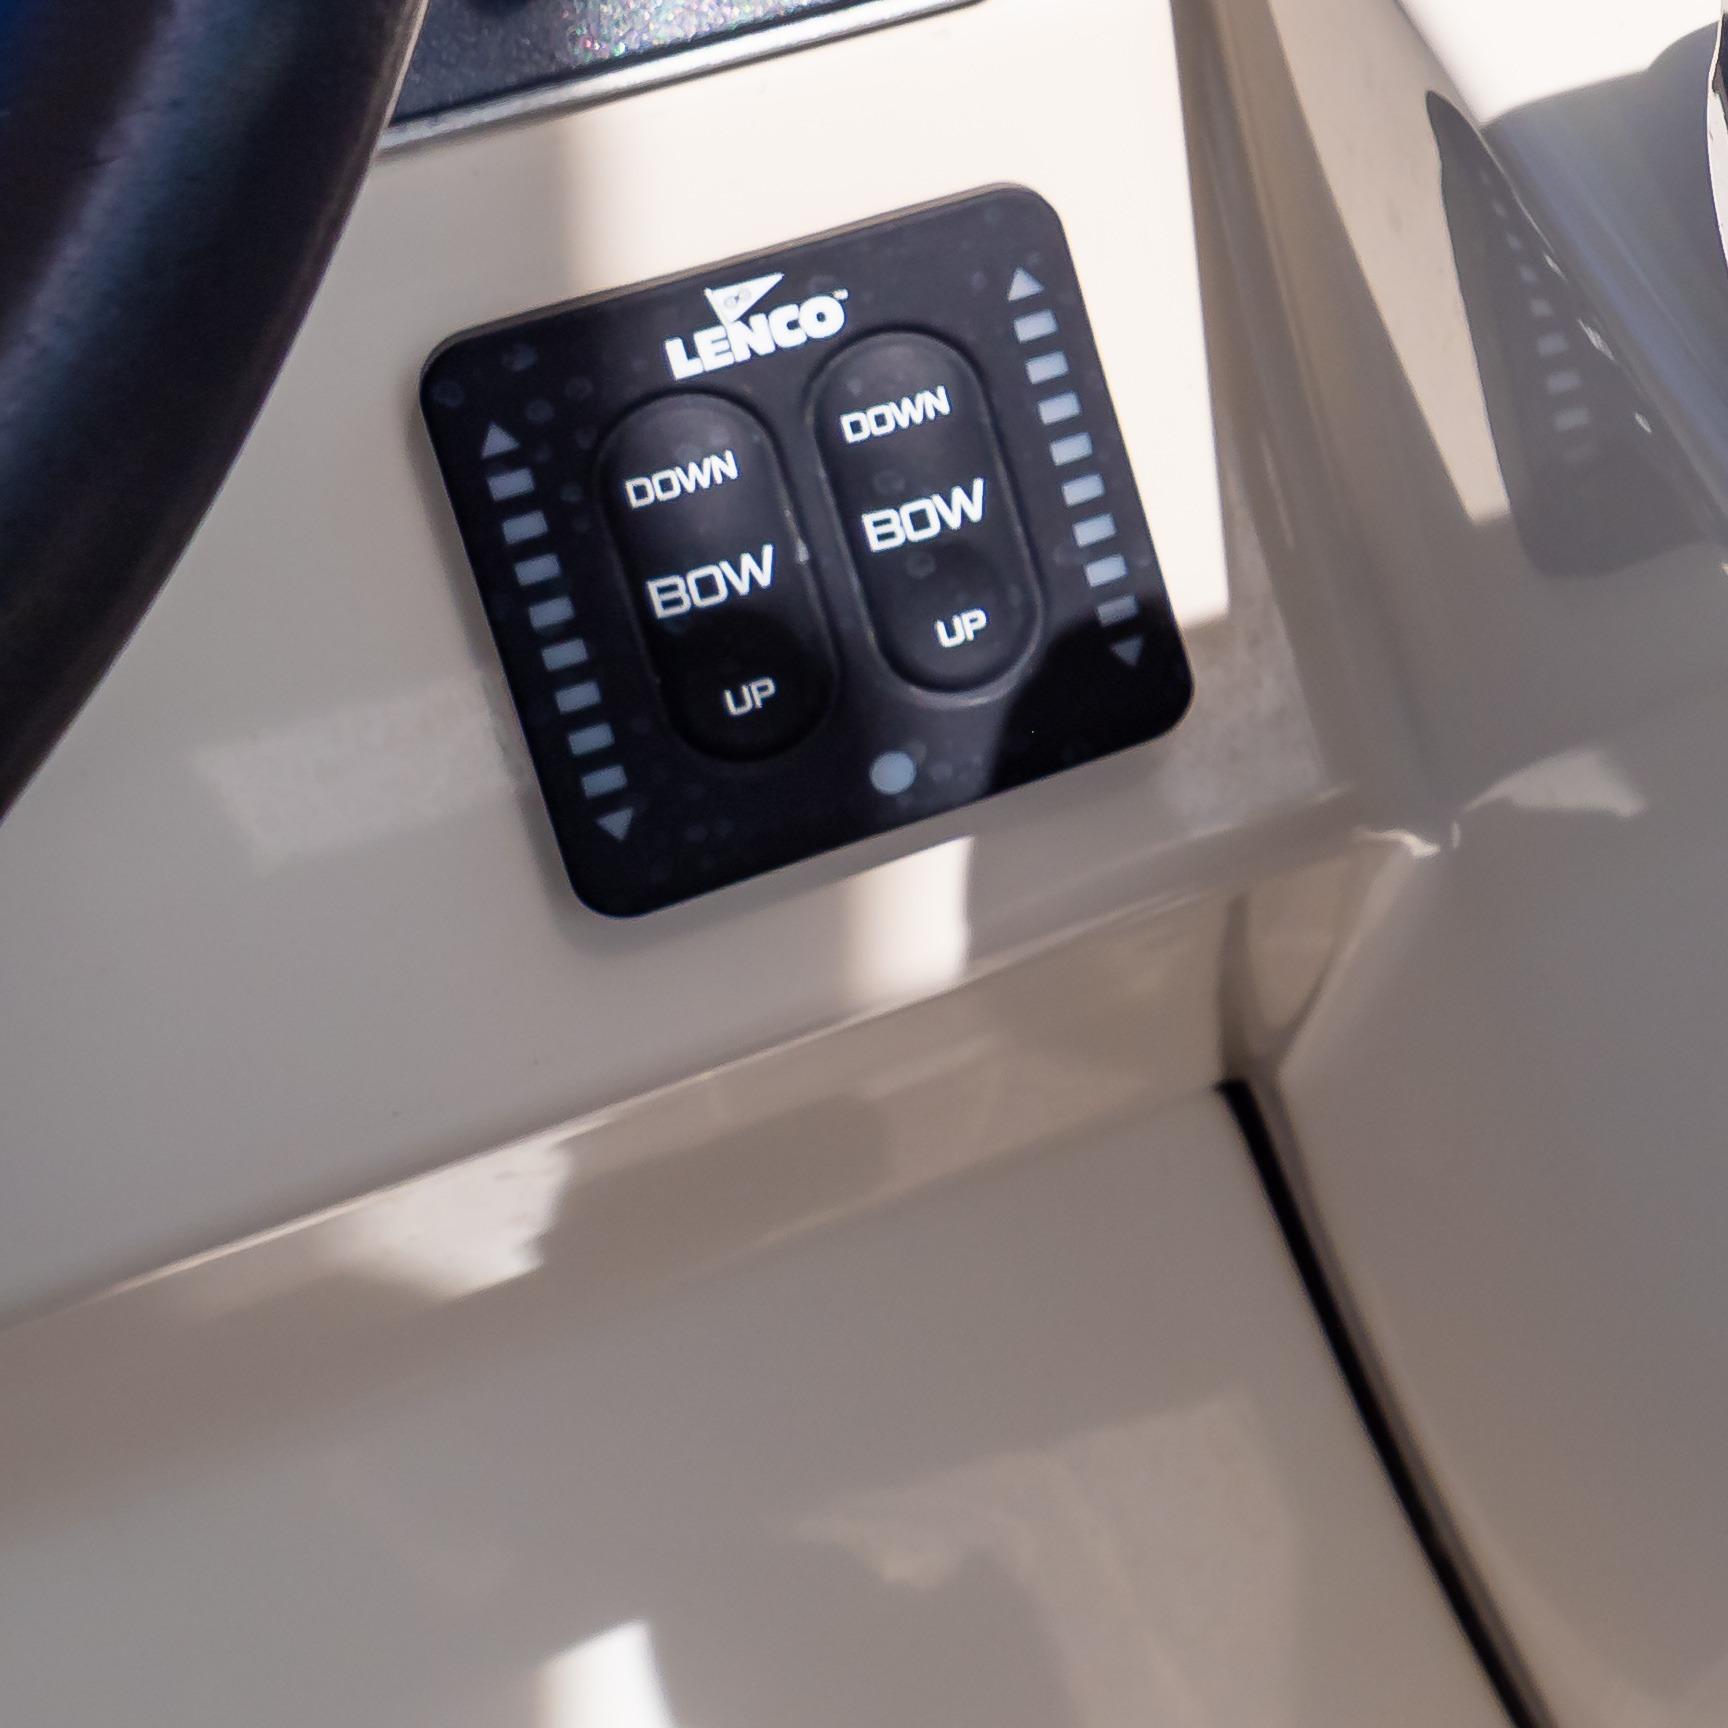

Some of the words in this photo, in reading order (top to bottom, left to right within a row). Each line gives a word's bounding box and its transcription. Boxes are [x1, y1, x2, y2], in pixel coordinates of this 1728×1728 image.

[664, 294, 846, 382] LENCO
[839, 385, 951, 445] DOWN
[625, 449, 738, 509] DOWN
[861, 477, 987, 553] BOW
[646, 544, 774, 620] BOW
[934, 608, 988, 648] UP
[724, 676, 776, 716] UP
